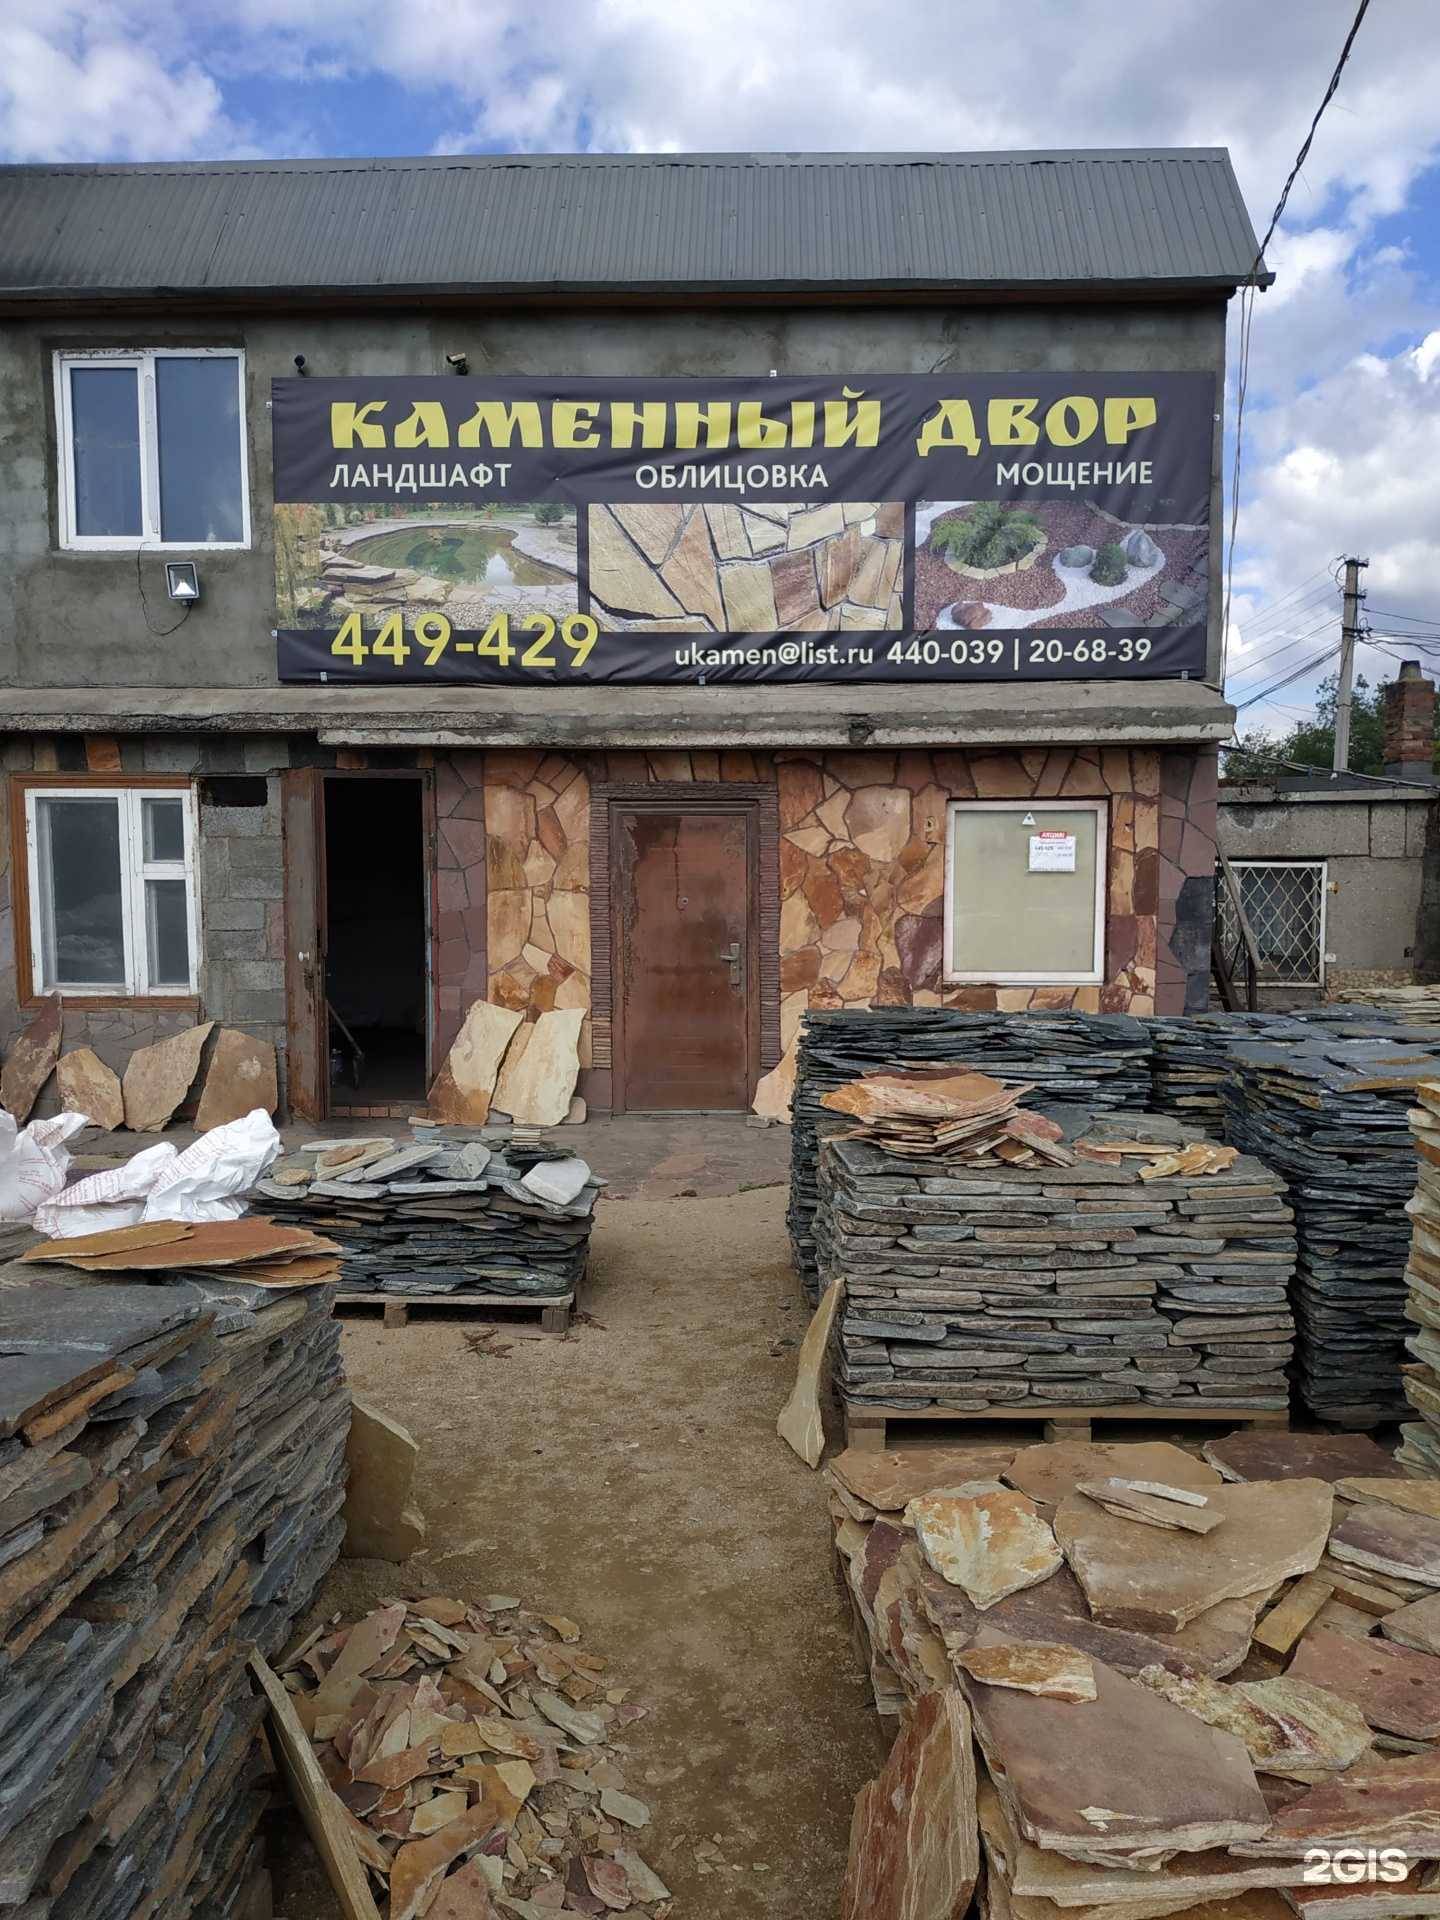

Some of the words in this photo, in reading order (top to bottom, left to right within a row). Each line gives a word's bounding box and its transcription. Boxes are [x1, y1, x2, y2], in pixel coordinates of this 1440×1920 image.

[331, 385, 882, 449] КАМЕННЫЙ
[915, 395, 1158, 457] ДВОР
[329, 462, 512, 494] ЛАНДШАФТ
[634, 464, 830, 493] ОБЛИЦОВКА
[995, 461, 1154, 491] МОЩЕНИЕ
[331, 612, 600, 668] 449-429
[674, 640, 875, 667] ukamen@list.ru
[885, 638, 1004, 666] 440-039
[1028, 637, 1153, 664] 20-68-39
